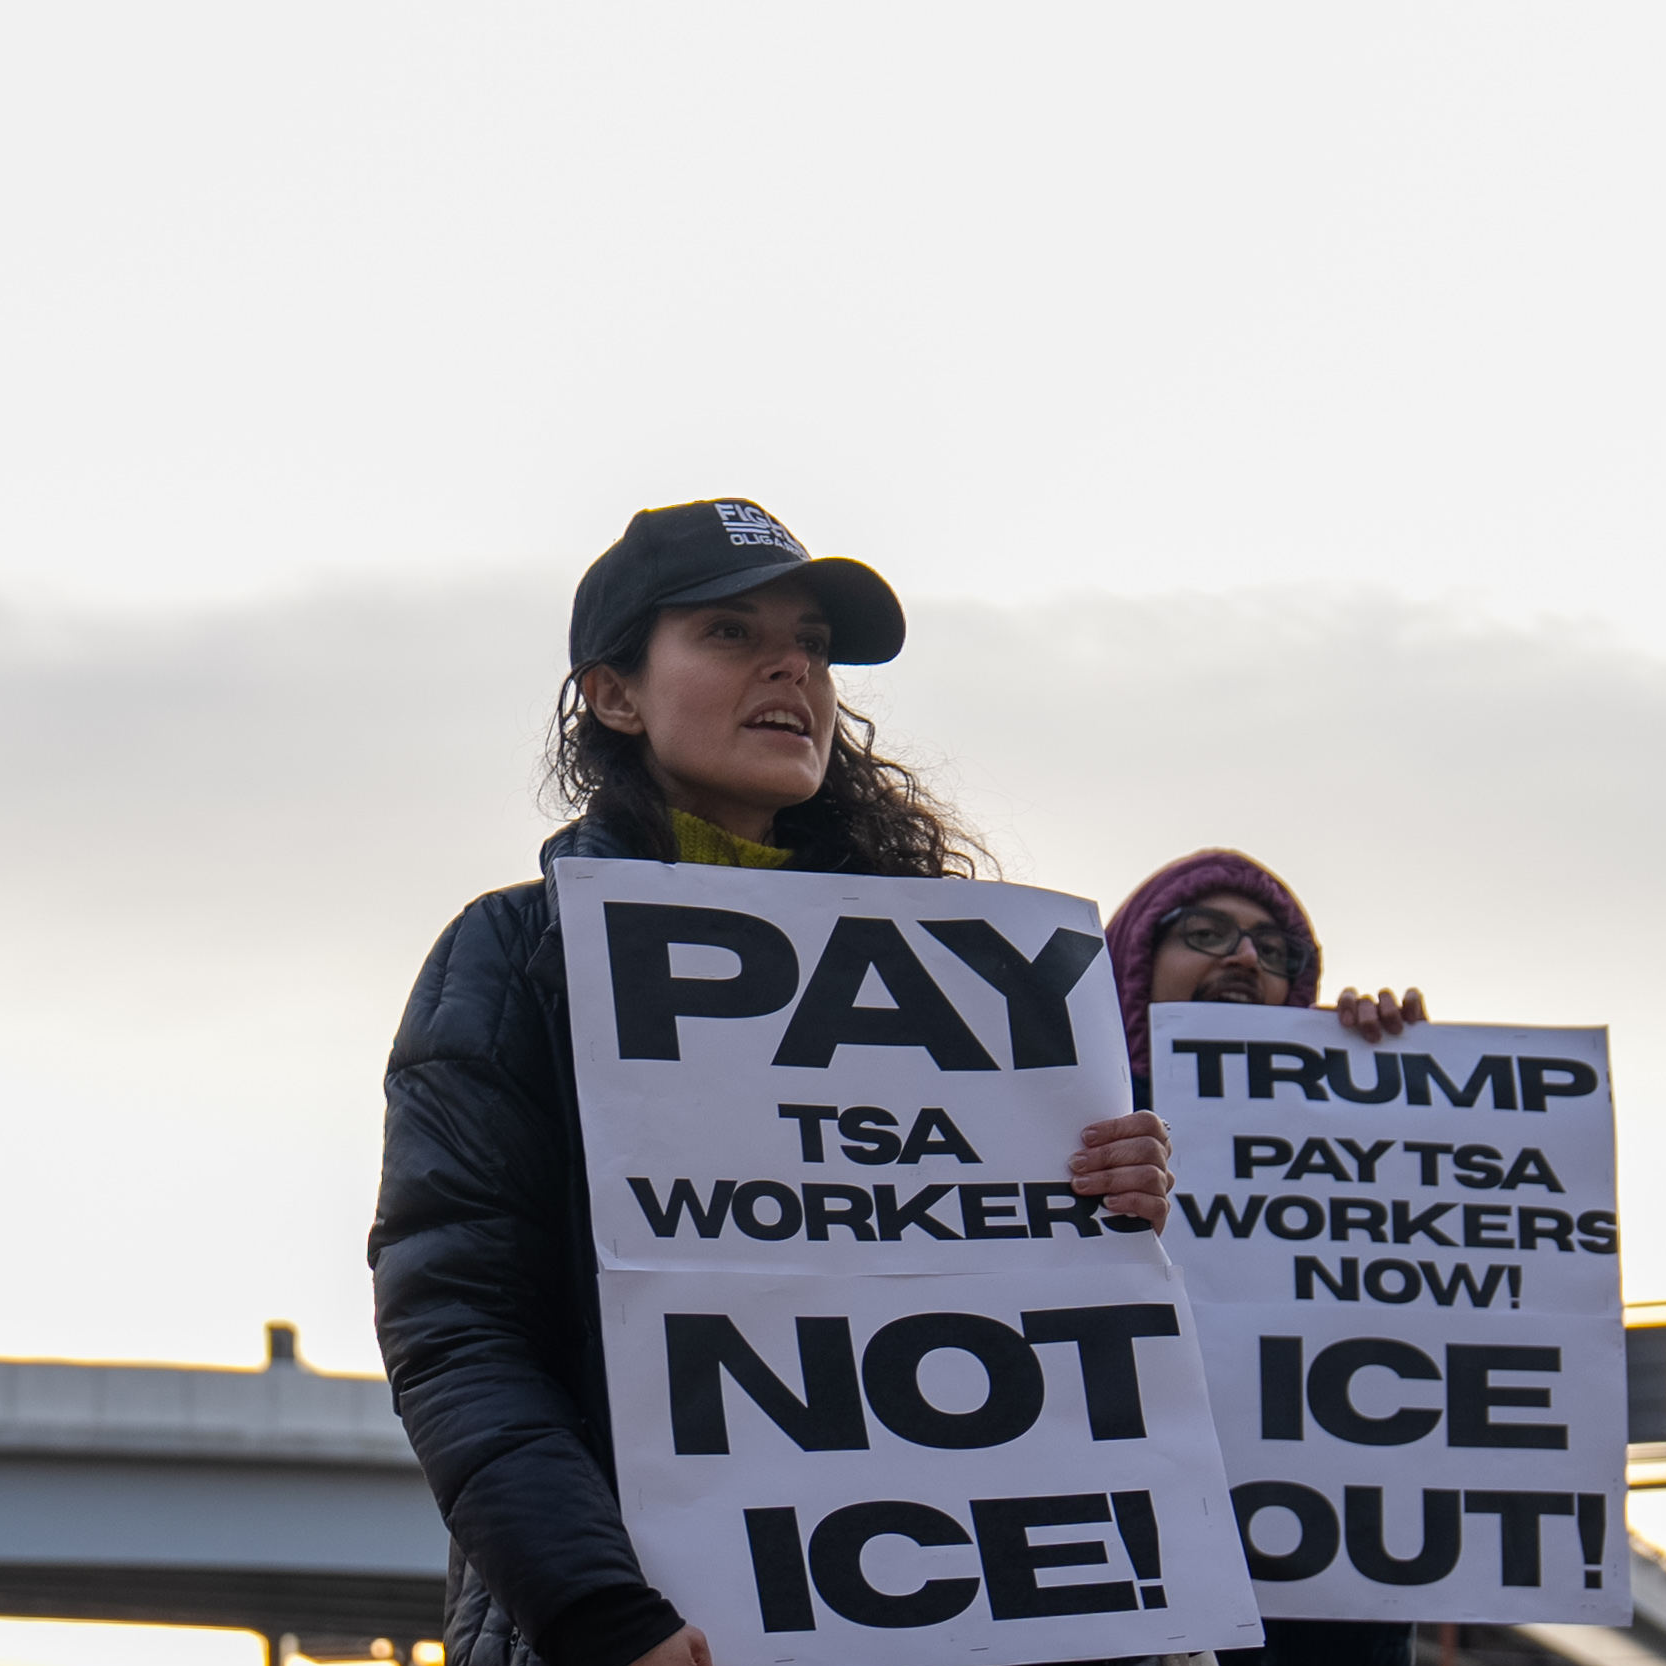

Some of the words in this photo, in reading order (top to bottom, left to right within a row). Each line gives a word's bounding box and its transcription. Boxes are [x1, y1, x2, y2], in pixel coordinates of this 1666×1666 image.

[715, 503, 805, 552] FIGH
[603, 901, 1105, 1071] PAY
[1172, 1039, 1598, 1112] TRUMP
[778, 1103, 983, 1165] TSA
[1234, 1135, 1396, 1183] PAY
[1403, 1140, 1566, 1193] TSA
[1175, 1193, 1618, 1254] WORKERS
[1294, 1255, 1522, 1309] NOW!
[663, 1303, 1181, 1455] NOT
[1259, 1335, 1568, 1450] ICE
[743, 1490, 1168, 1634] ICE!
[1229, 1480, 1606, 1589] OUT!
